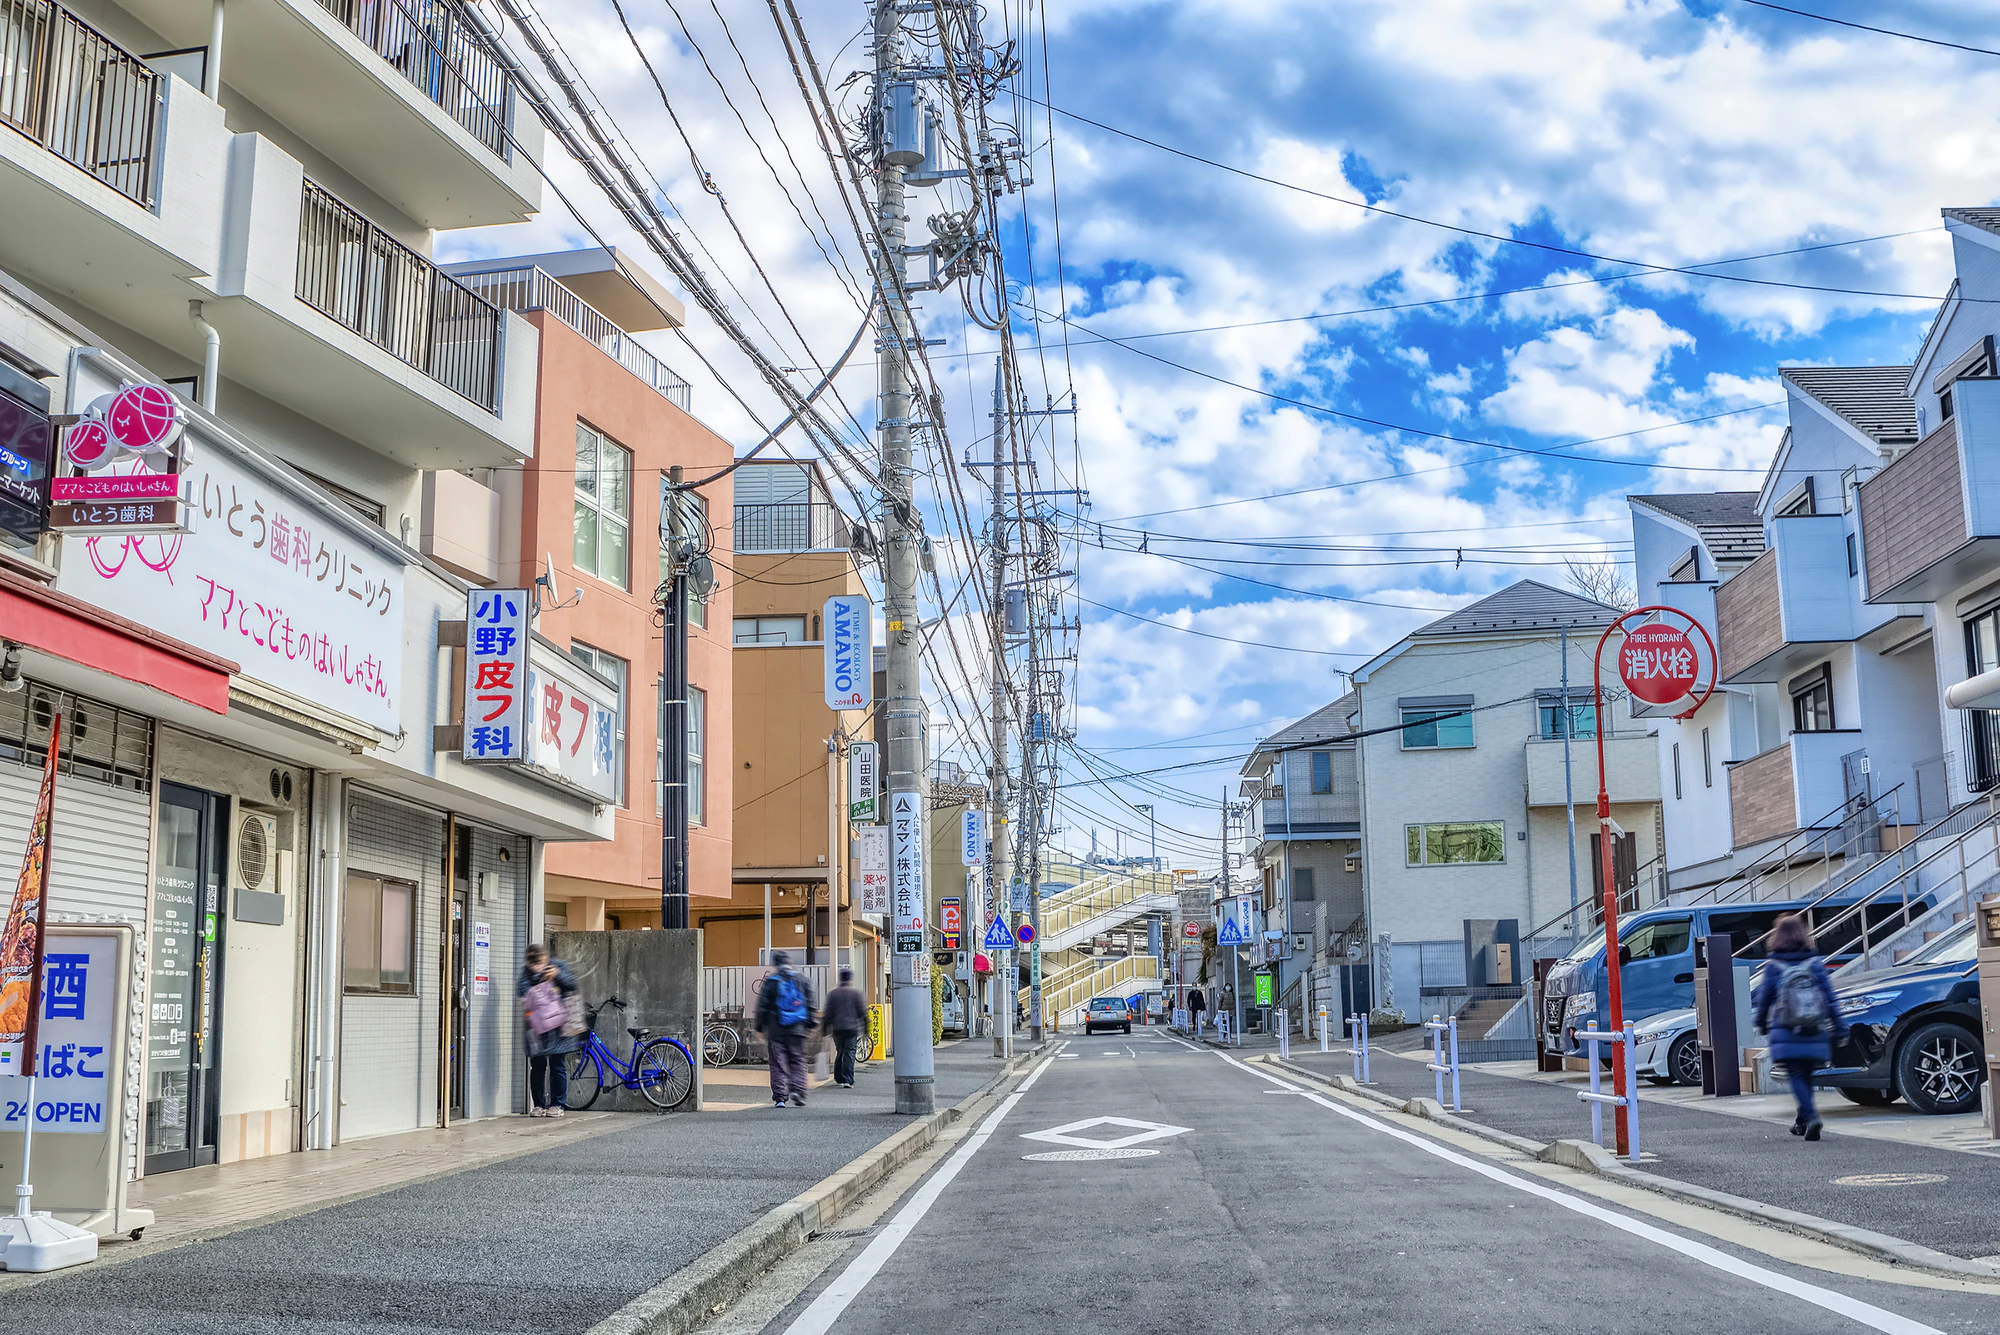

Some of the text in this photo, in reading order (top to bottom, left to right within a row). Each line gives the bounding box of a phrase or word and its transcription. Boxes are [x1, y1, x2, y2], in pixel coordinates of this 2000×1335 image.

[0, 448, 28, 471] グループ
[73, 505, 155, 523] いとう歯科
[203, 473, 391, 616] いとう歯科クリニック
[852, 610, 860, 632] TIME
[1630, 633, 1684, 643] FIRE HYDRANT
[834, 600, 853, 692] AMANO
[853, 643, 862, 683] ECOLOGY
[1625, 647, 1694, 680] 消火栓
[472, 594, 517, 756] 小野皮フ科
[860, 752, 872, 798] 山田医院
[966, 811, 976, 858] AMANO
[896, 819, 912, 917] アマノ株式会社
[41, 953, 90, 1020] 酒
[8, 1043, 104, 1079] ばこ
[36, 1101, 101, 1123] OPEN
